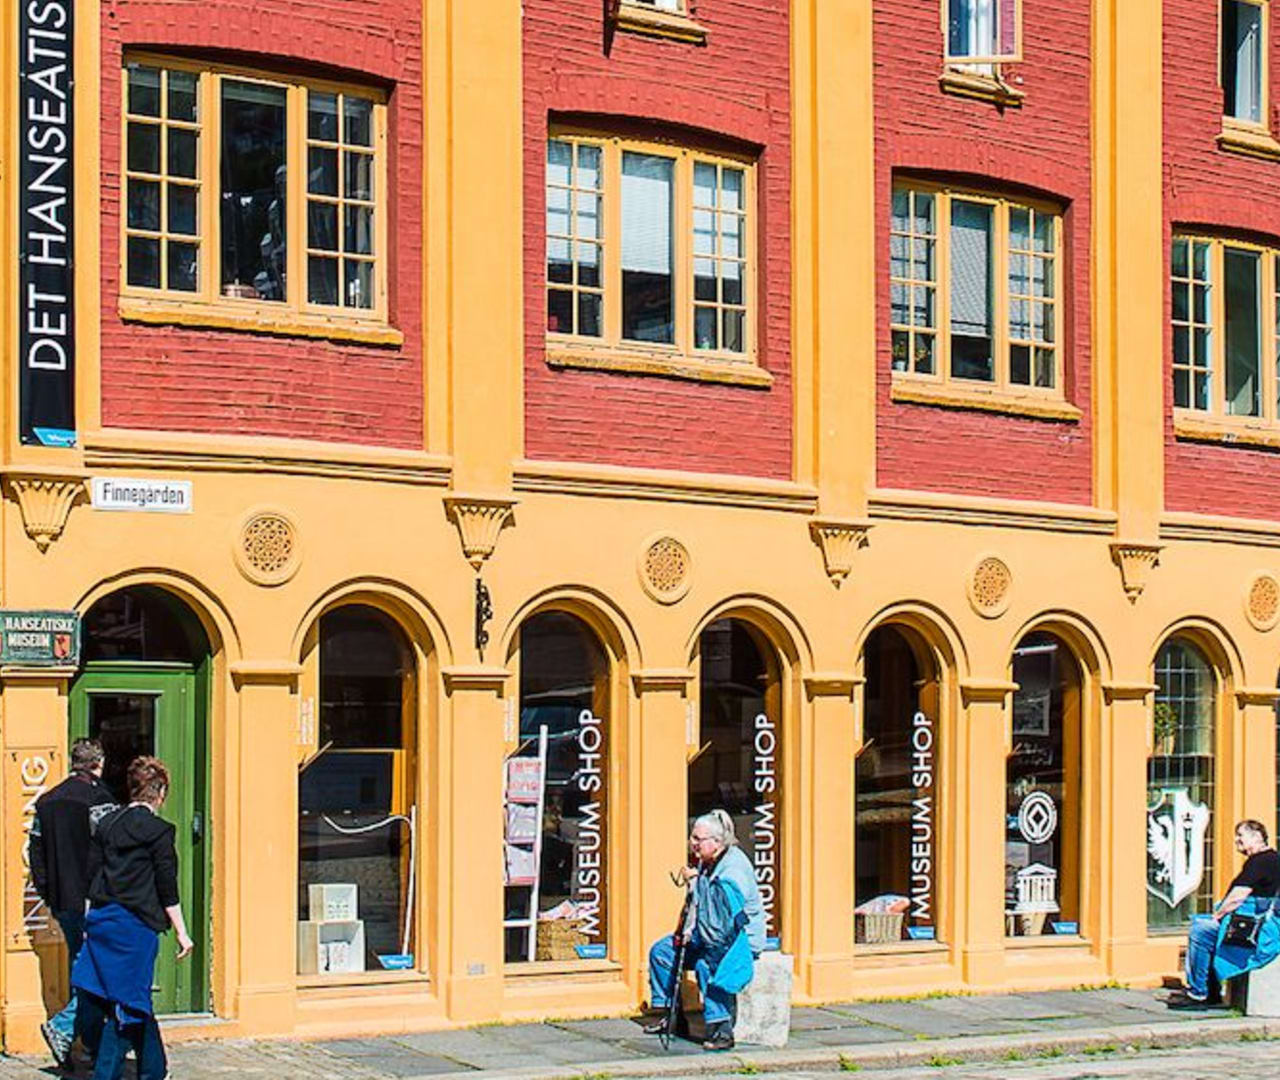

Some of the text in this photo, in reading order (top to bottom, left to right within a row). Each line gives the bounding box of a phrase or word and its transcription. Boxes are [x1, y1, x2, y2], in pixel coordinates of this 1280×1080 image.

[27, 282, 67, 371] DET
[102, 481, 185, 507] Finnegården
[5, 617, 74, 632] HANSEATISKE
[7, 634, 50, 647] MUSEUM
[578, 709, 602, 792] SHOP
[754, 713, 776, 793] SHOP
[912, 711, 933, 788] SHOP
[578, 802, 601, 936] MUSEUM
[910, 796, 932, 920] MUSEUM
